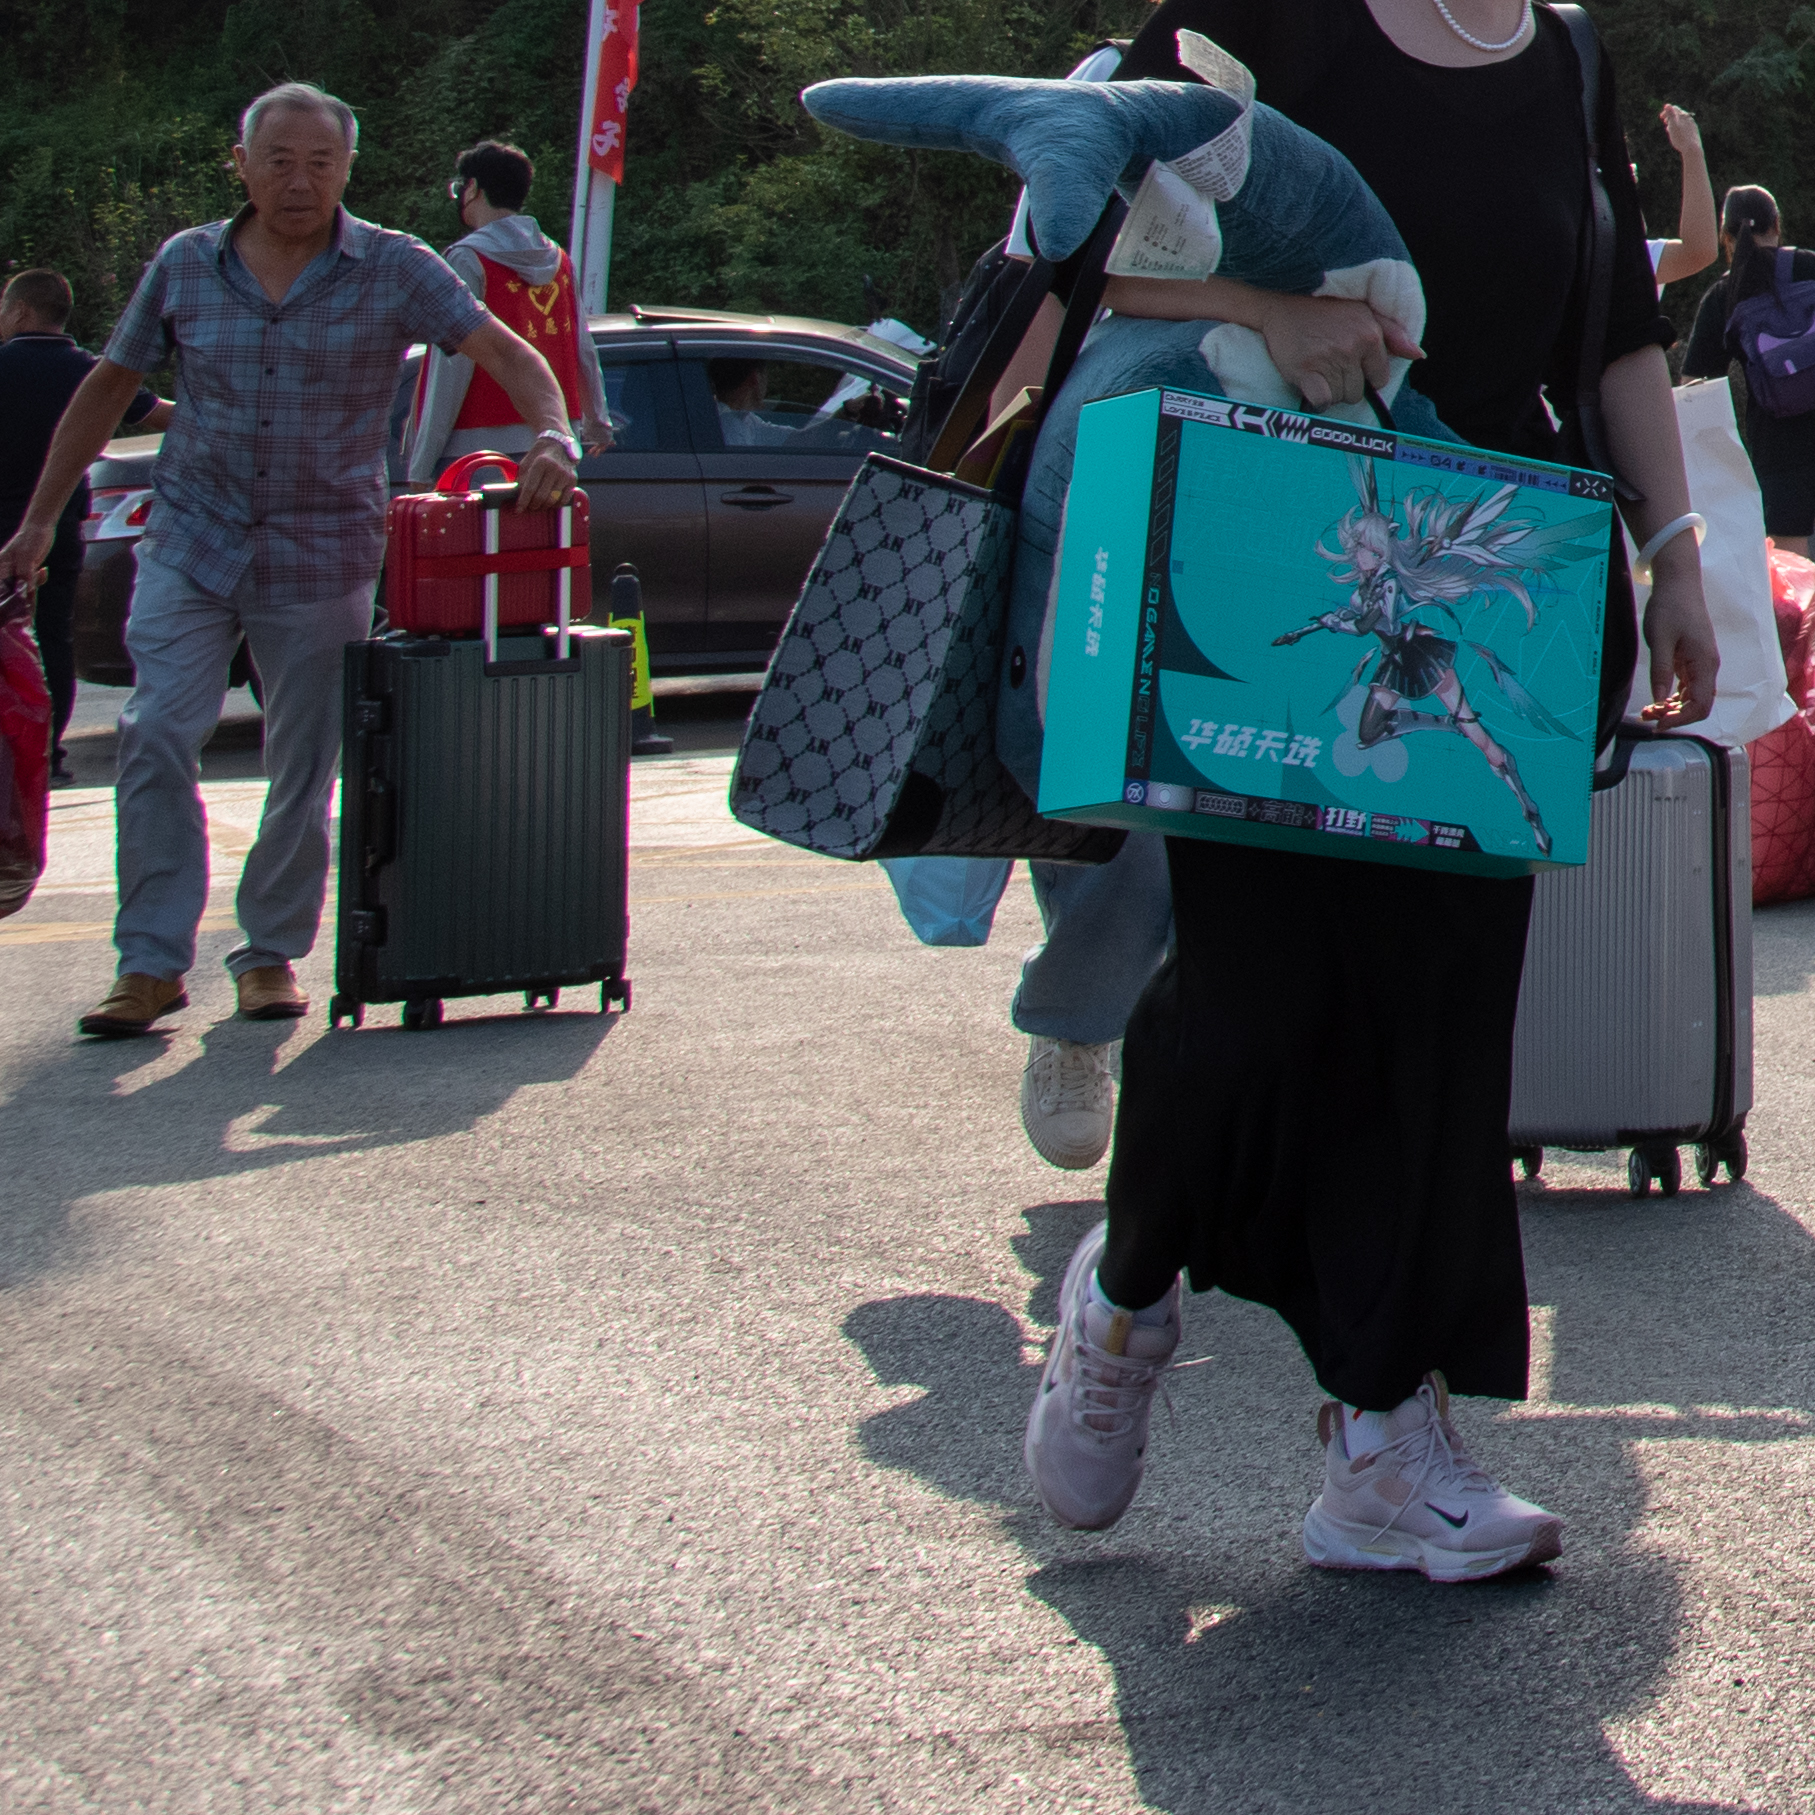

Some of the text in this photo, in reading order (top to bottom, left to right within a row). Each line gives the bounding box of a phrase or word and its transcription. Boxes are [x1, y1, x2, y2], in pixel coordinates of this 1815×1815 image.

[1084, 546, 1109, 657] 华硕天选
[1180, 718, 1323, 768] 华硕天选
[1260, 800, 1305, 826] 高能
[1326, 806, 1366, 830] 打野
